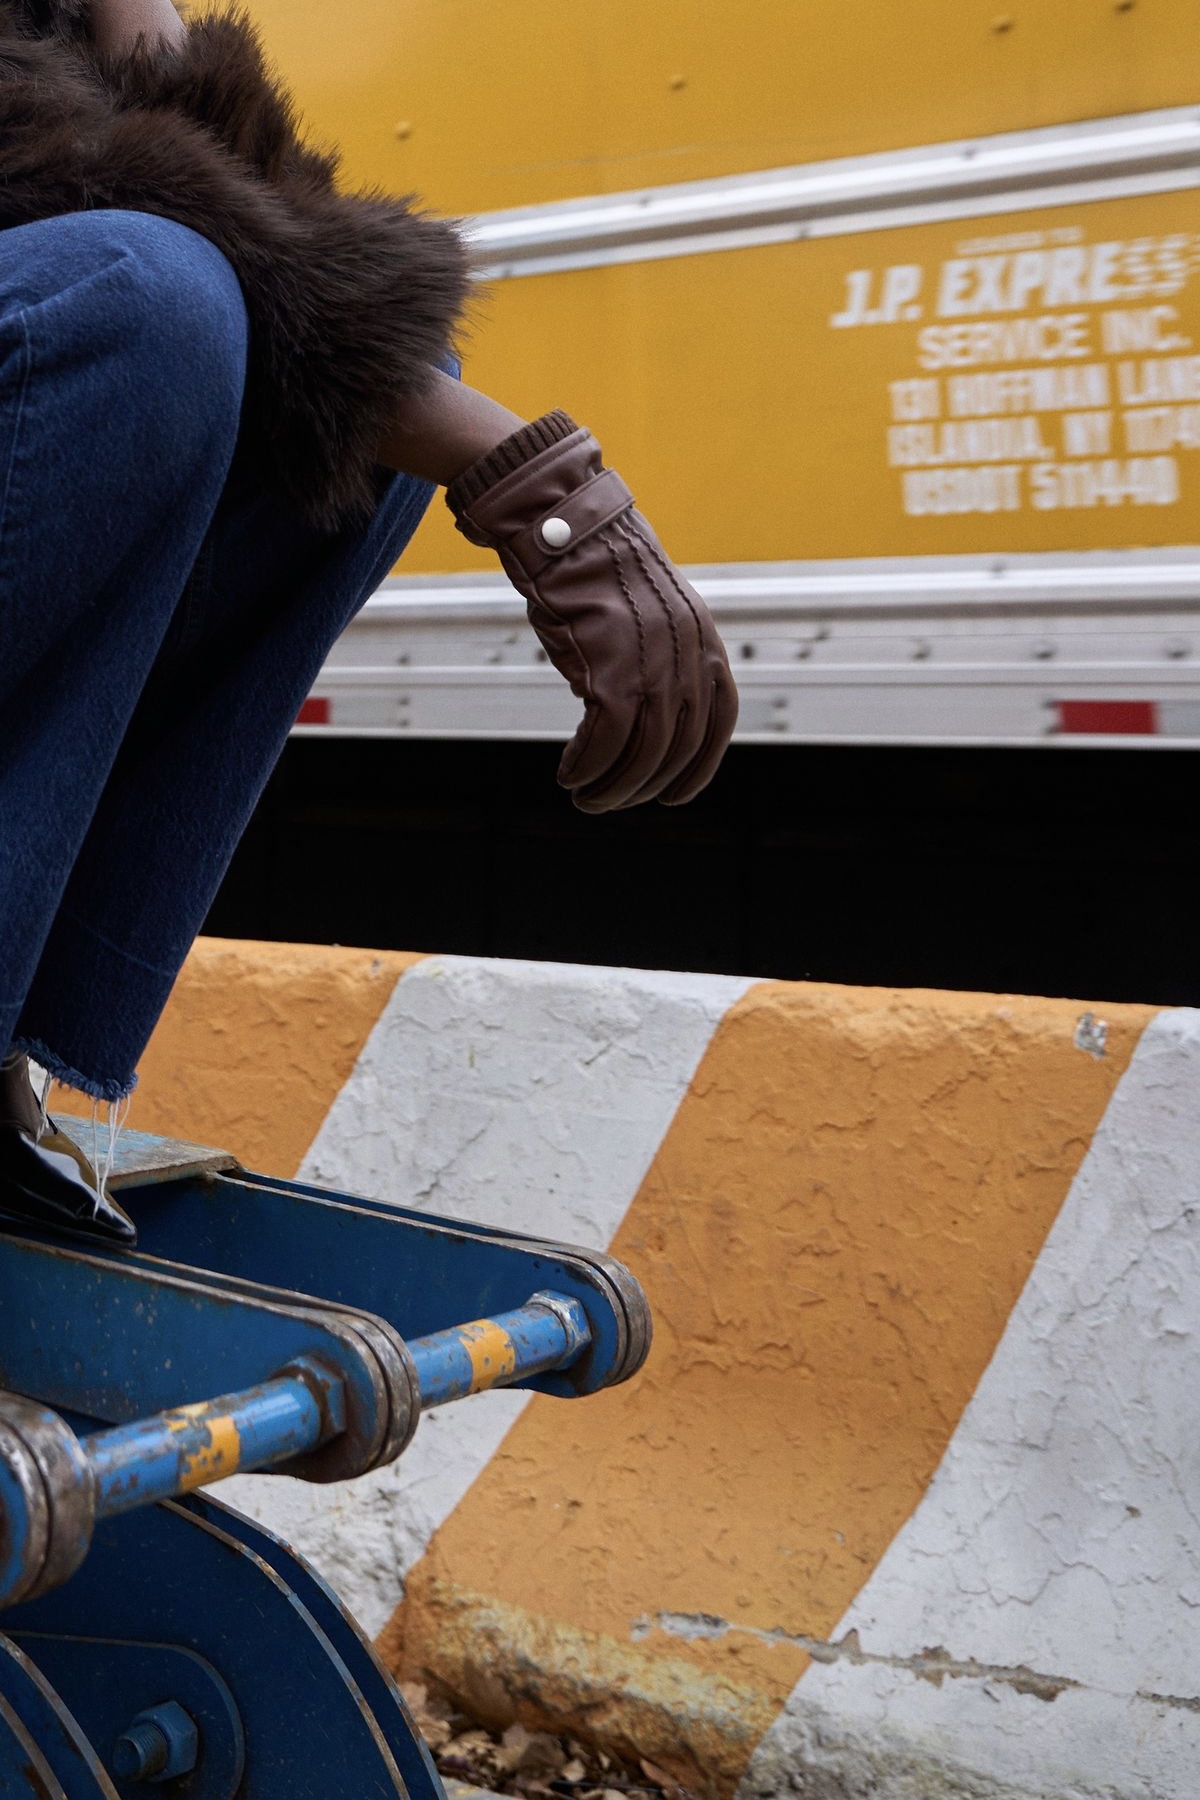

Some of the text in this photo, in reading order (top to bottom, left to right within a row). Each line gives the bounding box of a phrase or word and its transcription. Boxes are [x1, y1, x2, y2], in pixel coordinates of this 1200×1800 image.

[829, 232, 1200, 329] J.P. EXPRESS
[917, 304, 1191, 371] SERVICE INC.
